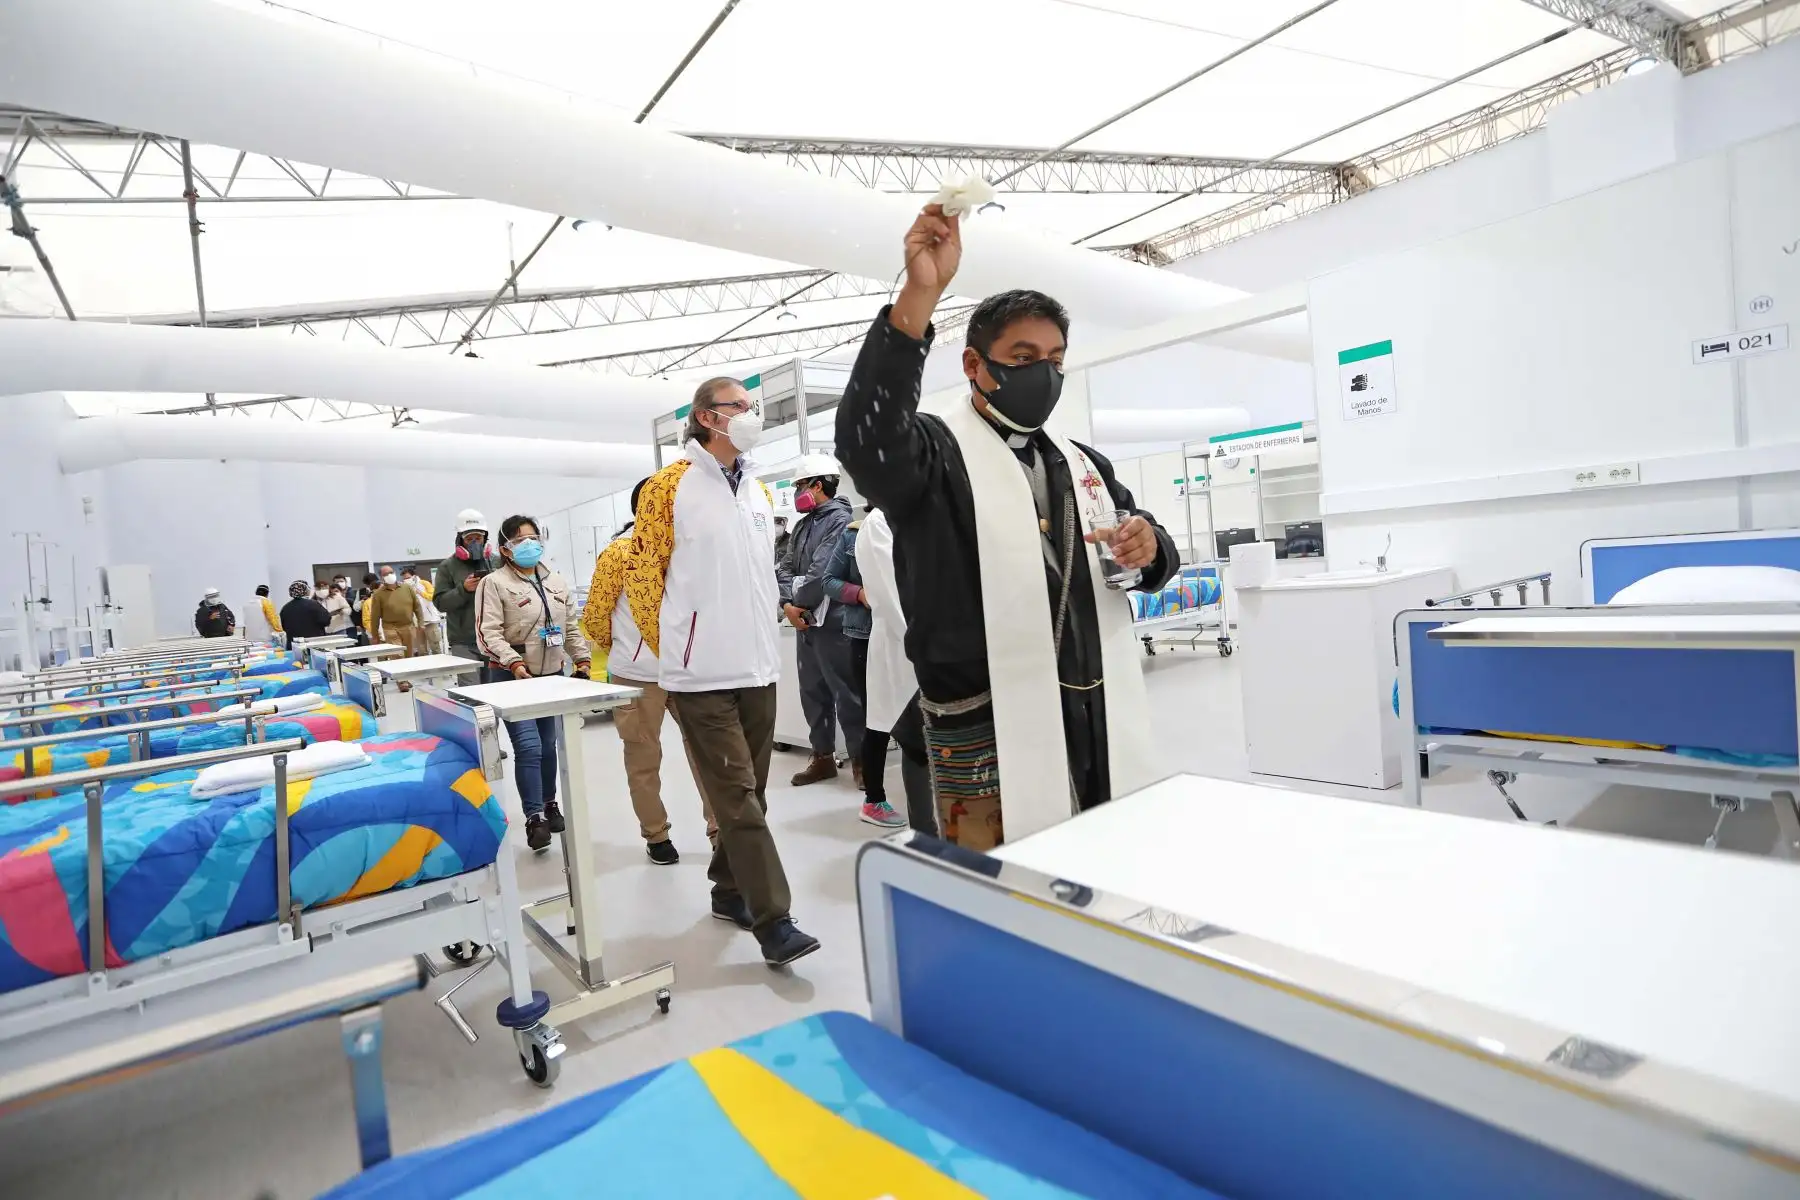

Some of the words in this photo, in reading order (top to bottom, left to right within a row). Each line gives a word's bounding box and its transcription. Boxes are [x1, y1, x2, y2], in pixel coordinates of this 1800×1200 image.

[1738, 332, 1772, 351] 021
[1350, 399, 1377, 410] Lavado
[1377, 396, 1388, 405] de
[1357, 406, 1382, 416] Manos
[1254, 440, 1262, 449] DE
[1263, 435, 1300, 448] ENFERMERAS
[978, 786, 999, 796] CUS
